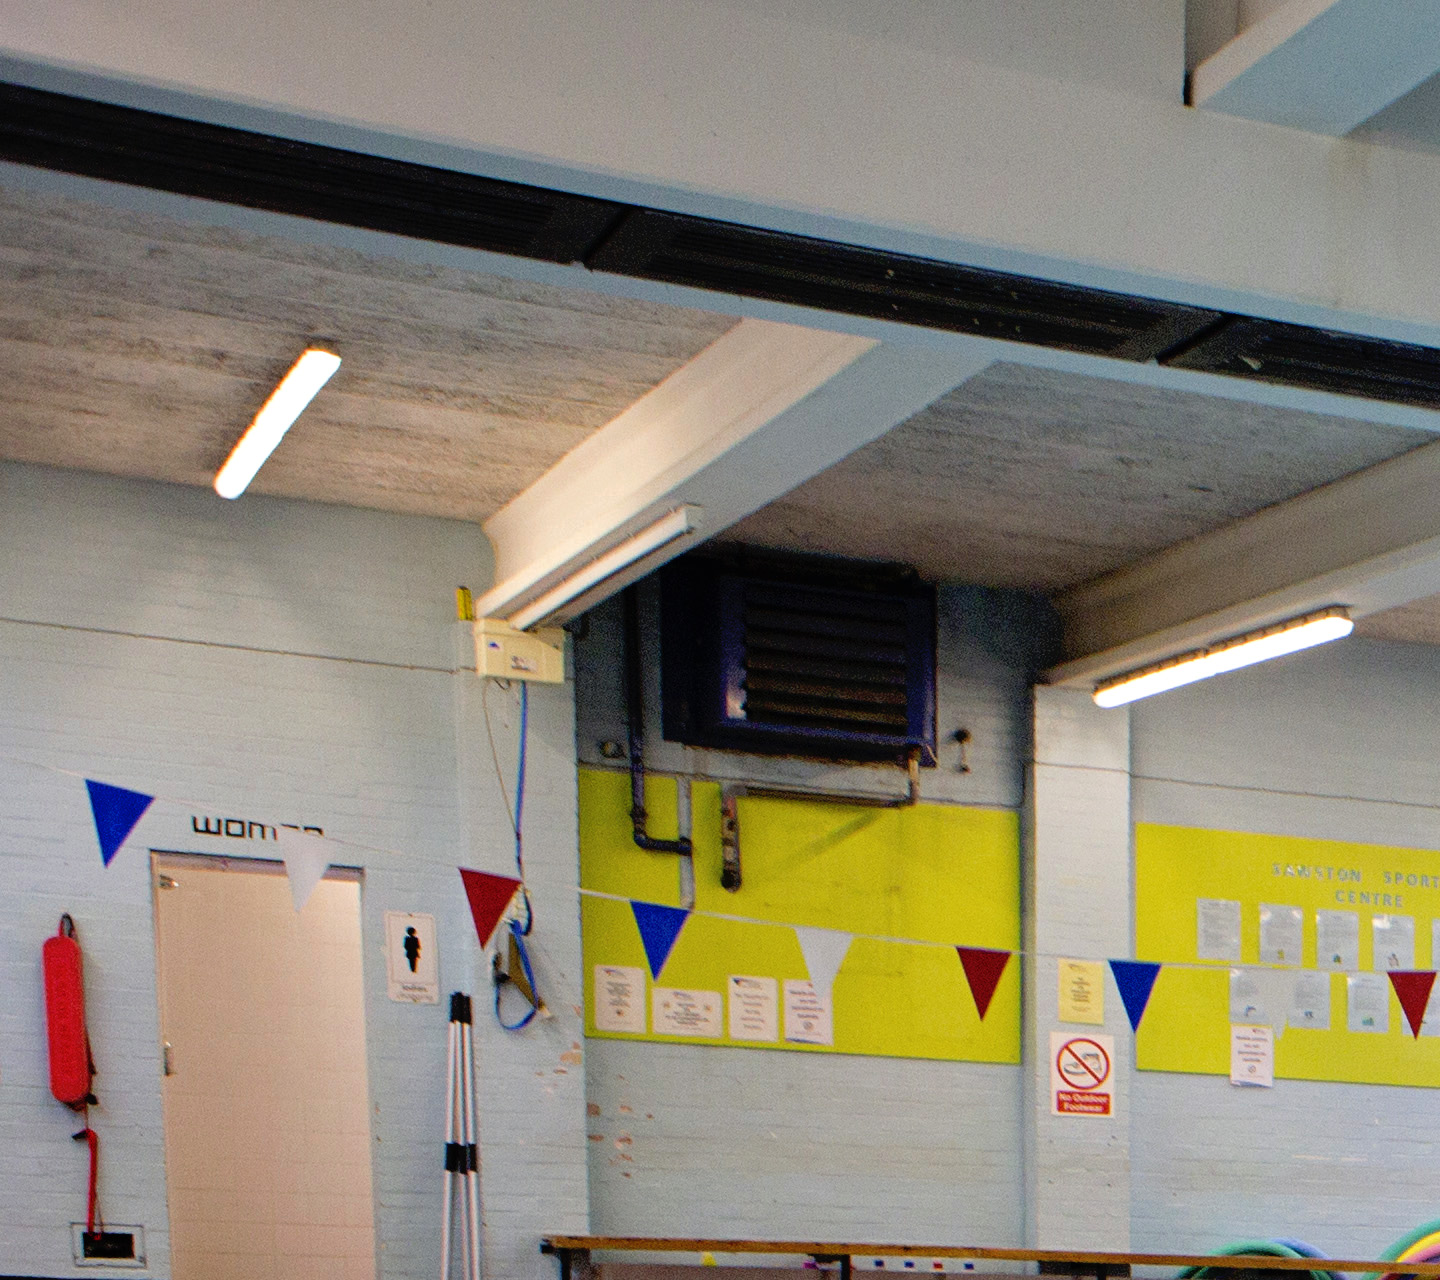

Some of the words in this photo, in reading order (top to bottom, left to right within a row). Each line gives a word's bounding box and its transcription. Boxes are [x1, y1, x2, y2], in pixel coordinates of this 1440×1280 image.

[191, 814, 325, 841] wom
[1272, 863, 1363, 883] SAWSTON
[1335, 890, 1404, 908] CENTRE
